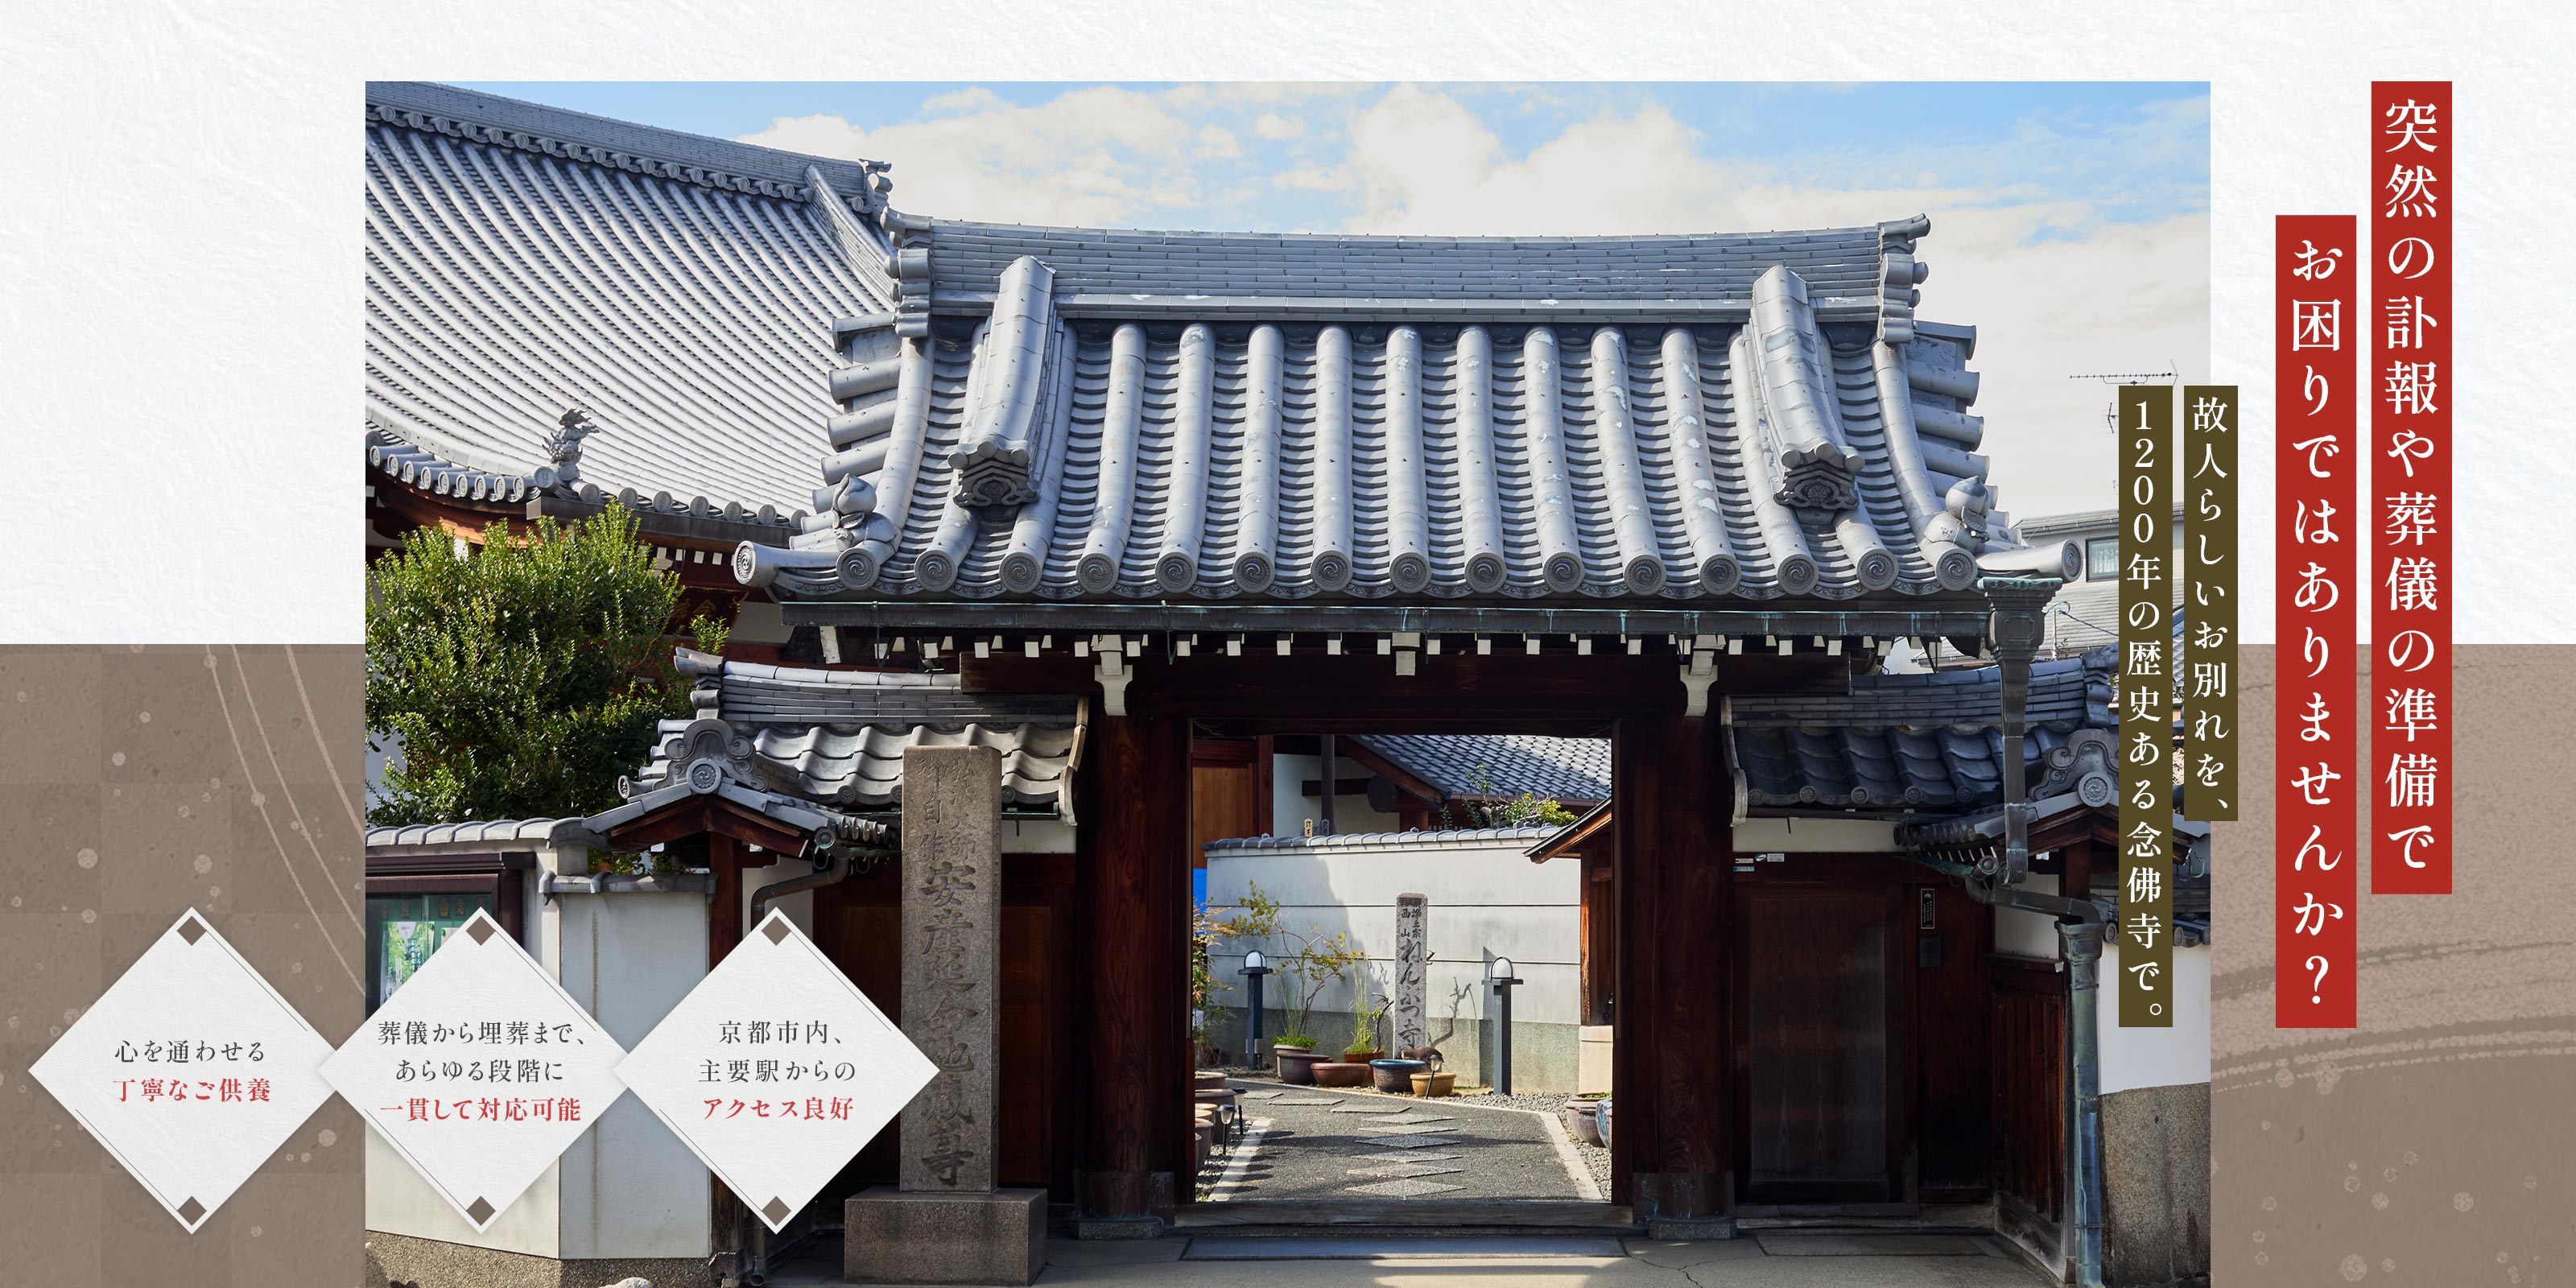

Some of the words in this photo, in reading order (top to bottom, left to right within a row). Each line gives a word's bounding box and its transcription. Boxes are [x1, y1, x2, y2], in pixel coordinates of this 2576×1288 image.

[1398, 939, 1422, 1048] ねんぶつ寺
